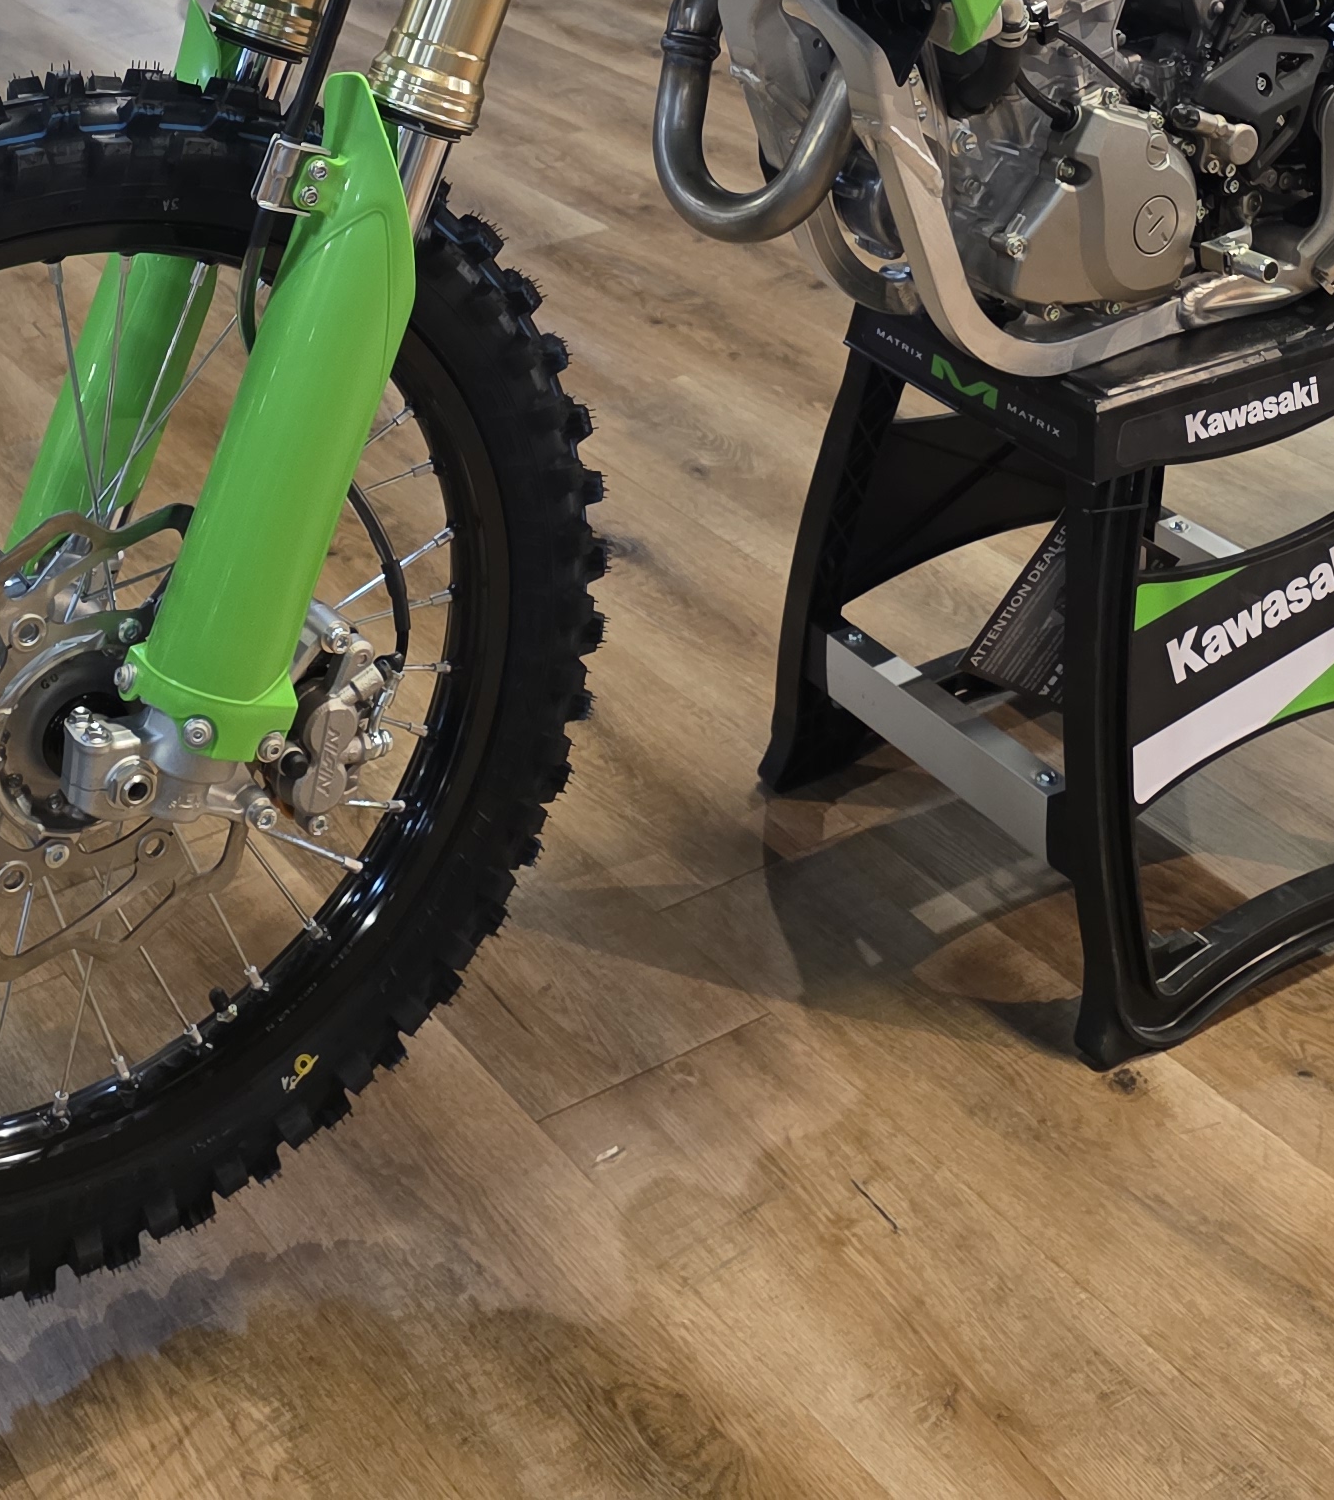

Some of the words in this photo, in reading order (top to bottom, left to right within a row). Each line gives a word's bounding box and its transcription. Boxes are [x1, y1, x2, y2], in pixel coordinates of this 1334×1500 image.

[876, 327, 923, 361] MATRIX
[1006, 402, 1061, 438] MATRIX
[1184, 376, 1320, 443] Kawasaki
[969, 583, 1033, 667] ATTENTION
